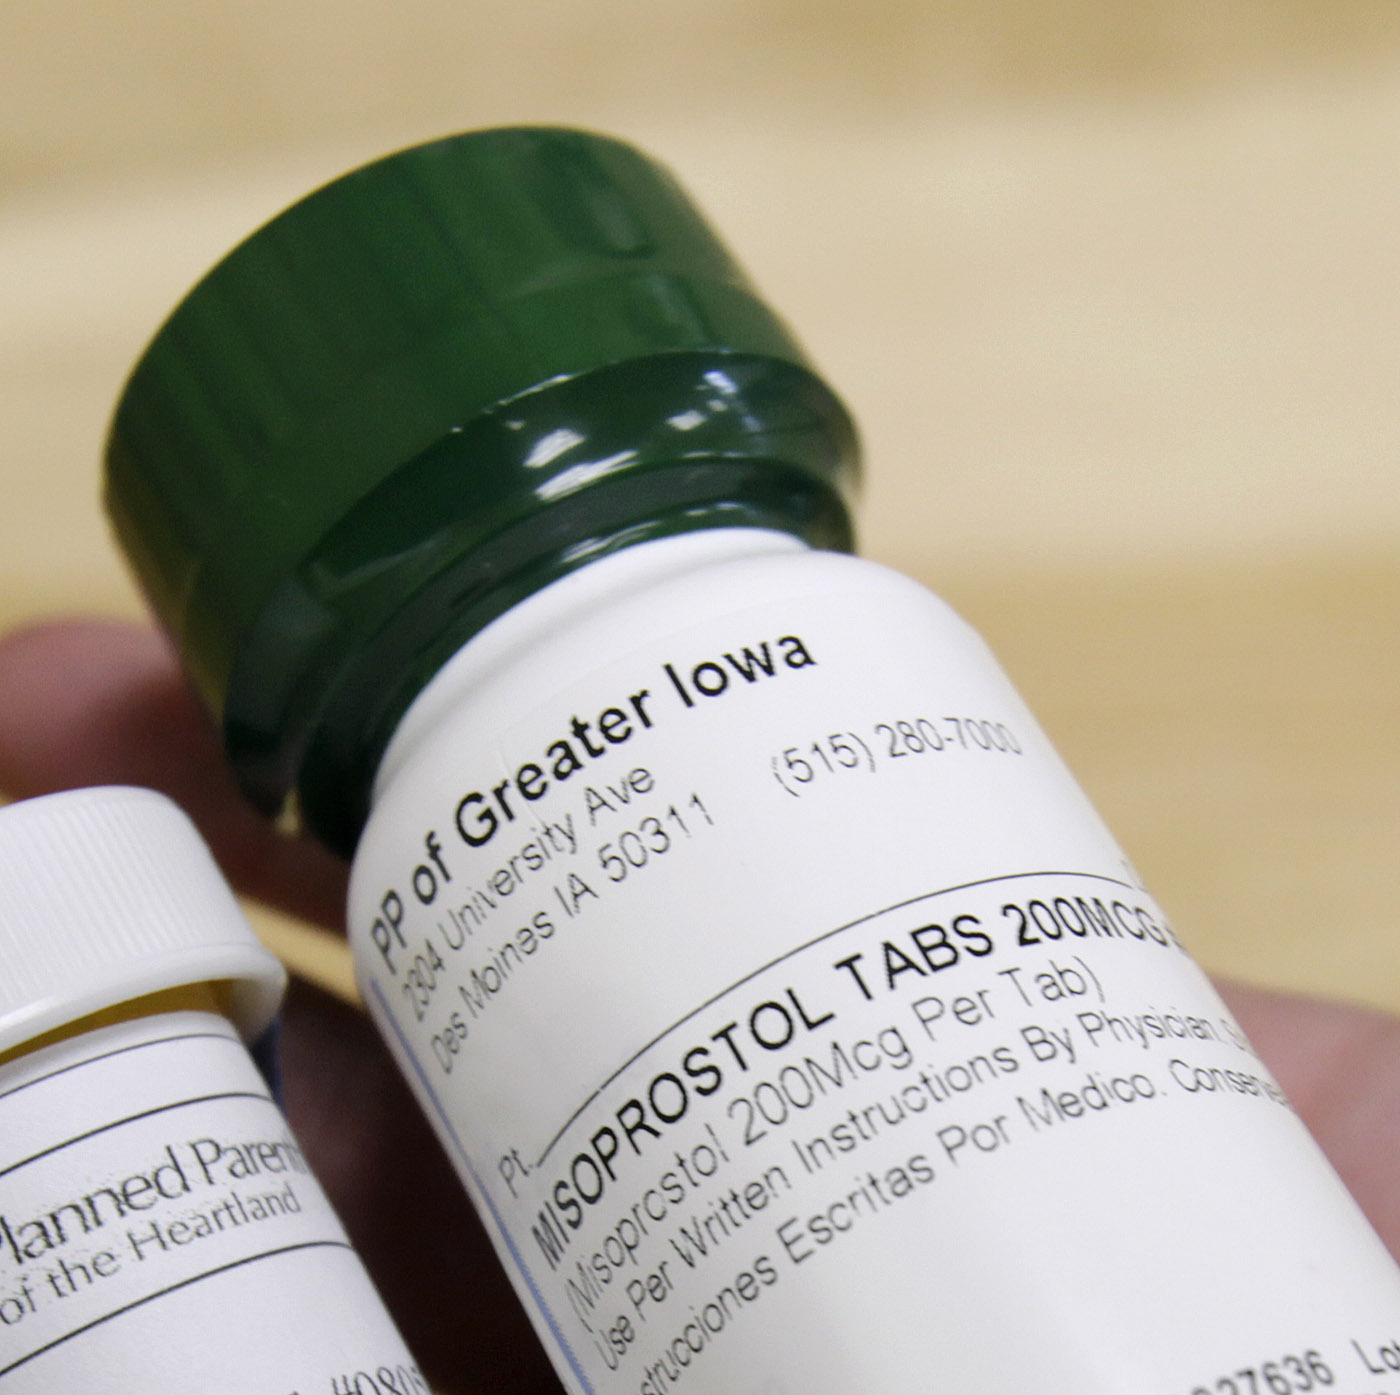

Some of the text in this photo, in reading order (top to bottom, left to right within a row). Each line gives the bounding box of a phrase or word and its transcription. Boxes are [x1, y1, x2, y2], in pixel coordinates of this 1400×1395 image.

[370, 633, 819, 976] PP of Greater Iowa
[403, 761, 656, 1023] 2304 University Ave
[430, 717, 1023, 1075] Des Moines IA 50311 (515) 280-7000
[531, 986, 836, 1272] MISOPROSTOL
[835, 913, 995, 1003] TABS
[594, 1306, 637, 1372] Use
[625, 1256, 675, 1327] Per
[674, 1163, 793, 1268] Written
[791, 1040, 1021, 1173] Instructions
[1021, 1015, 1077, 1068] By
[728, 1022, 914, 1145] 200Mcg
[912, 980, 995, 1036] Per
[997, 955, 1105, 1007] Tab)
[775, 1152, 937, 1262] Escritas
[937, 1110, 1014, 1167] Por
[1016, 1072, 1167, 1132] Medico.
[46, 1254, 124, 1301] the
[128, 1182, 302, 1261] Heartland
